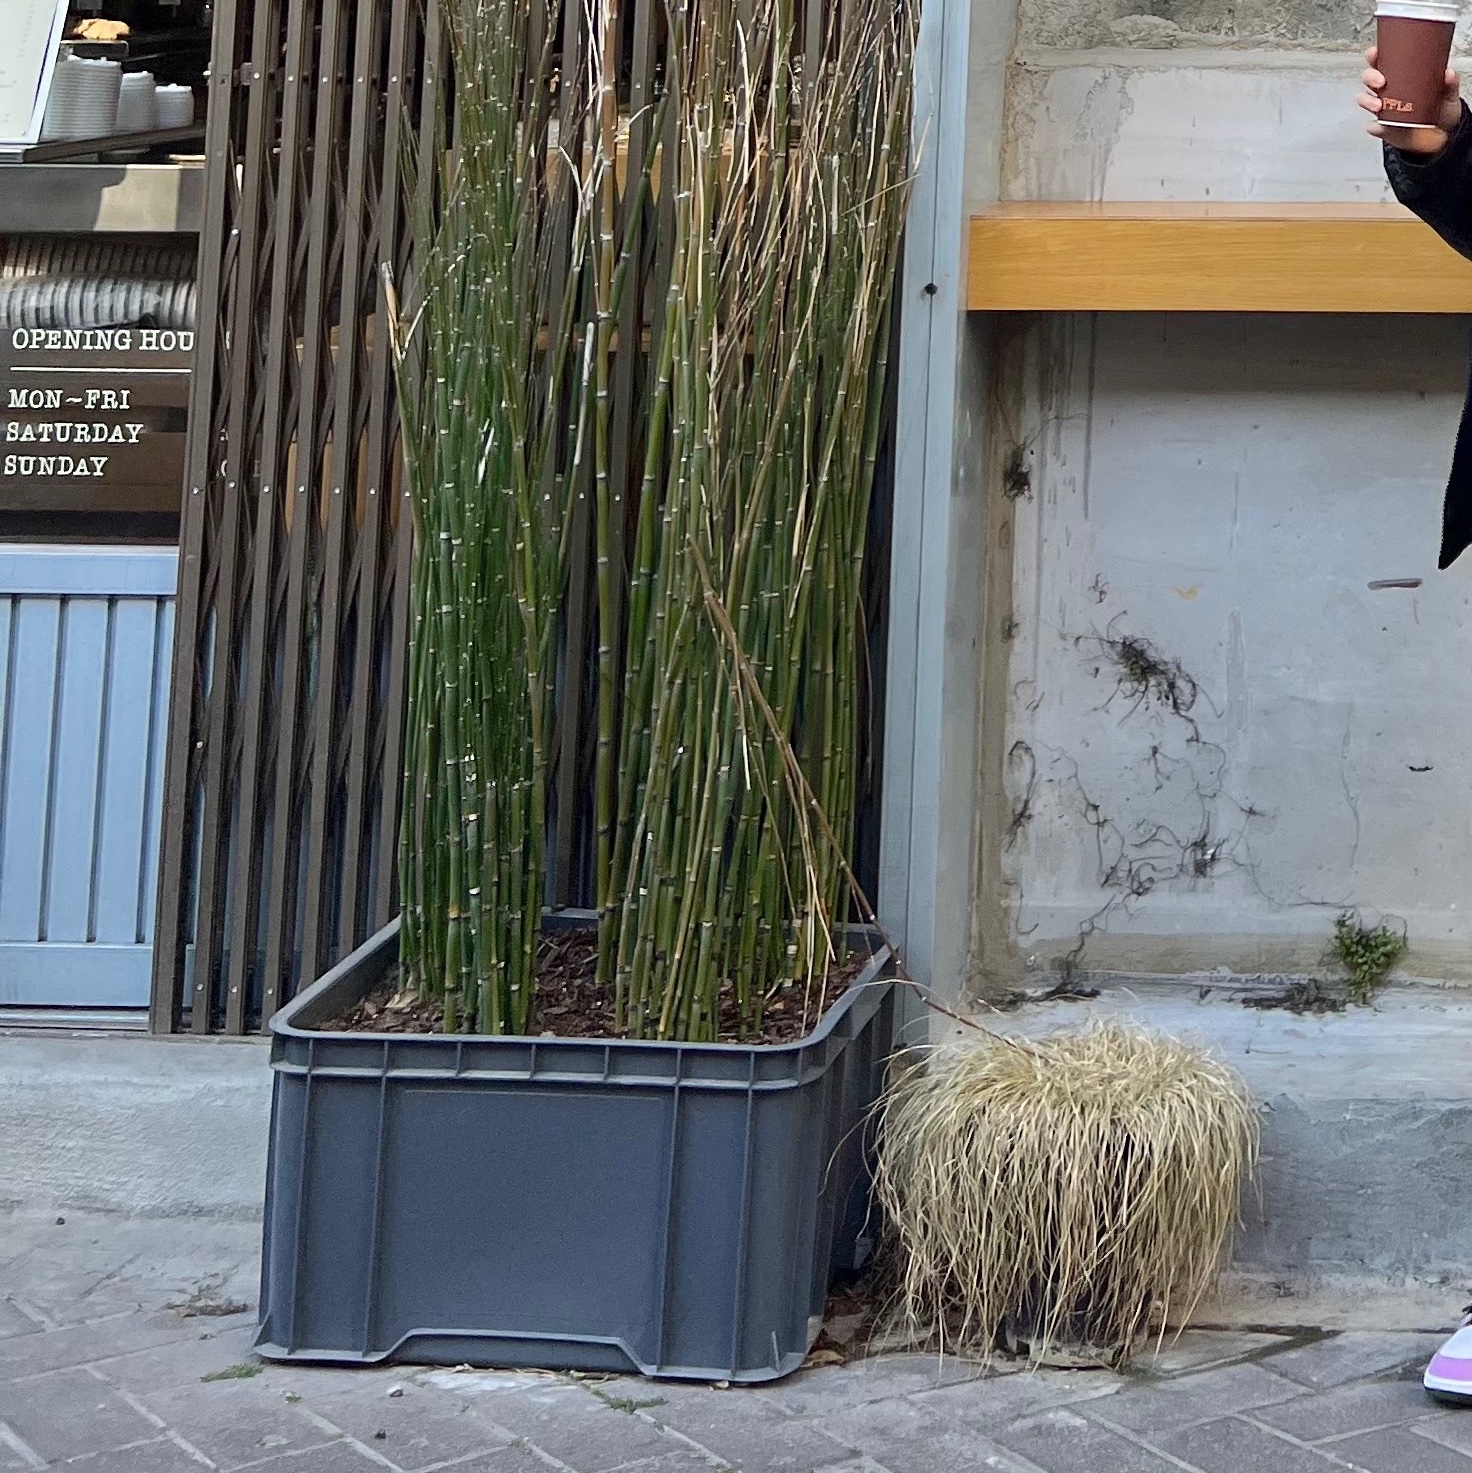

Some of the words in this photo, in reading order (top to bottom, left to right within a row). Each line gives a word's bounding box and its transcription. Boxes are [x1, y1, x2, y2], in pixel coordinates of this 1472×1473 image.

[12, 328, 132, 351] OPENING
[138, 330, 195, 351] HOU
[6, 422, 144, 443] SATURDAY
[4, 455, 109, 477] SUNDAY
